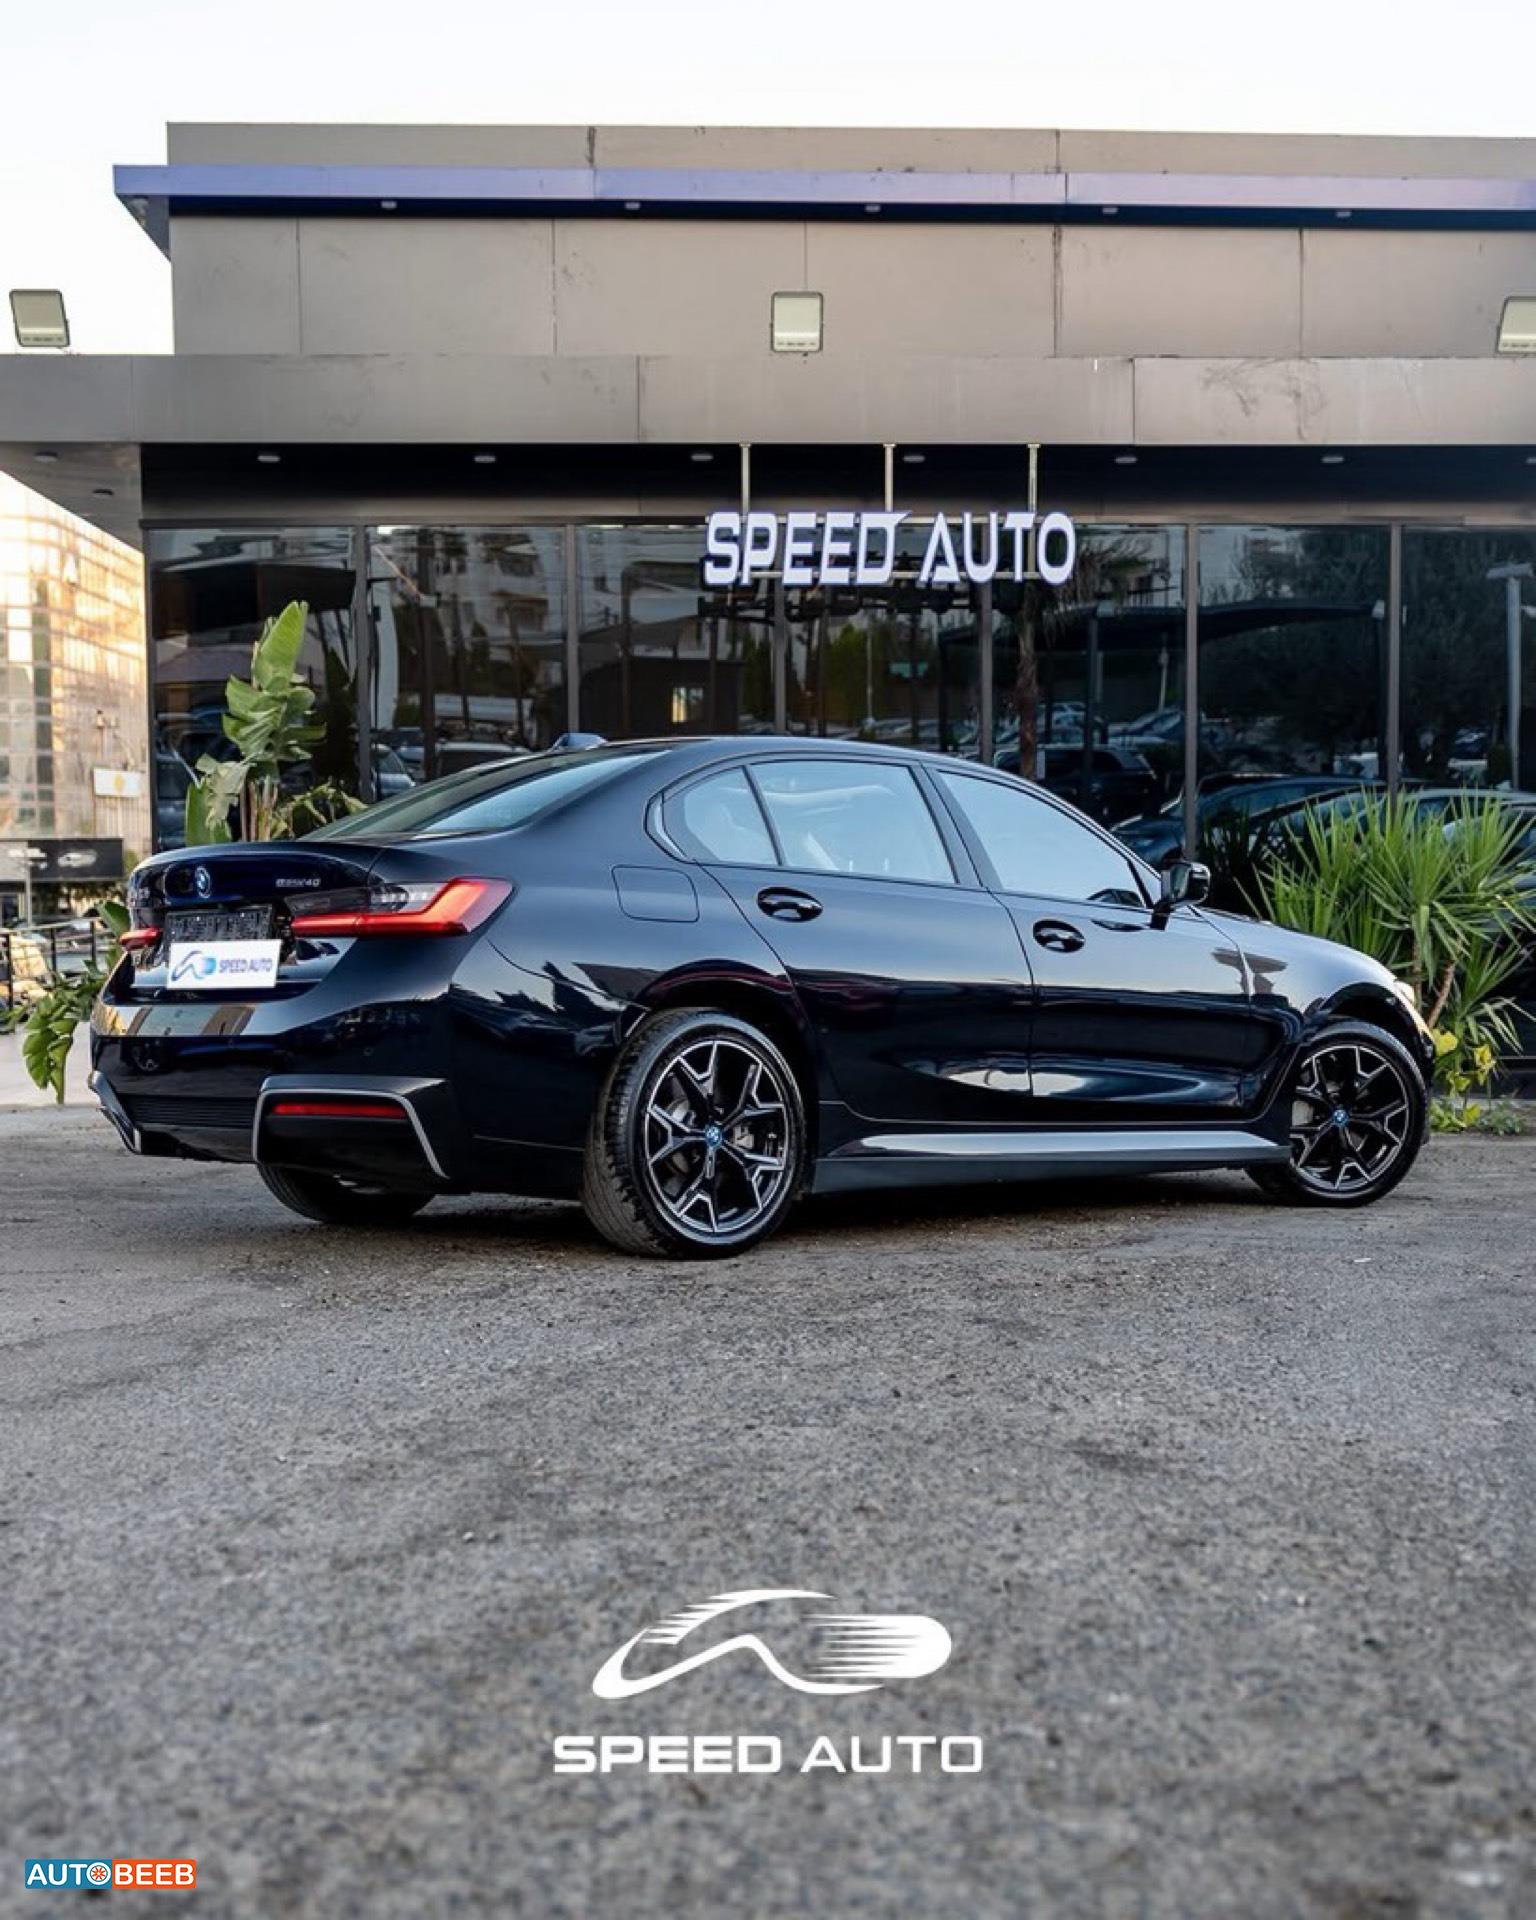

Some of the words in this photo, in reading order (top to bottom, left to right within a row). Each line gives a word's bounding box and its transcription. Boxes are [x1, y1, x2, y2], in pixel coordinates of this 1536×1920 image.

[704, 511, 912, 585] SPEED
[918, 511, 1077, 585] AUTO
[219, 959, 248, 974] SPEED
[249, 958, 273, 973] AUTO
